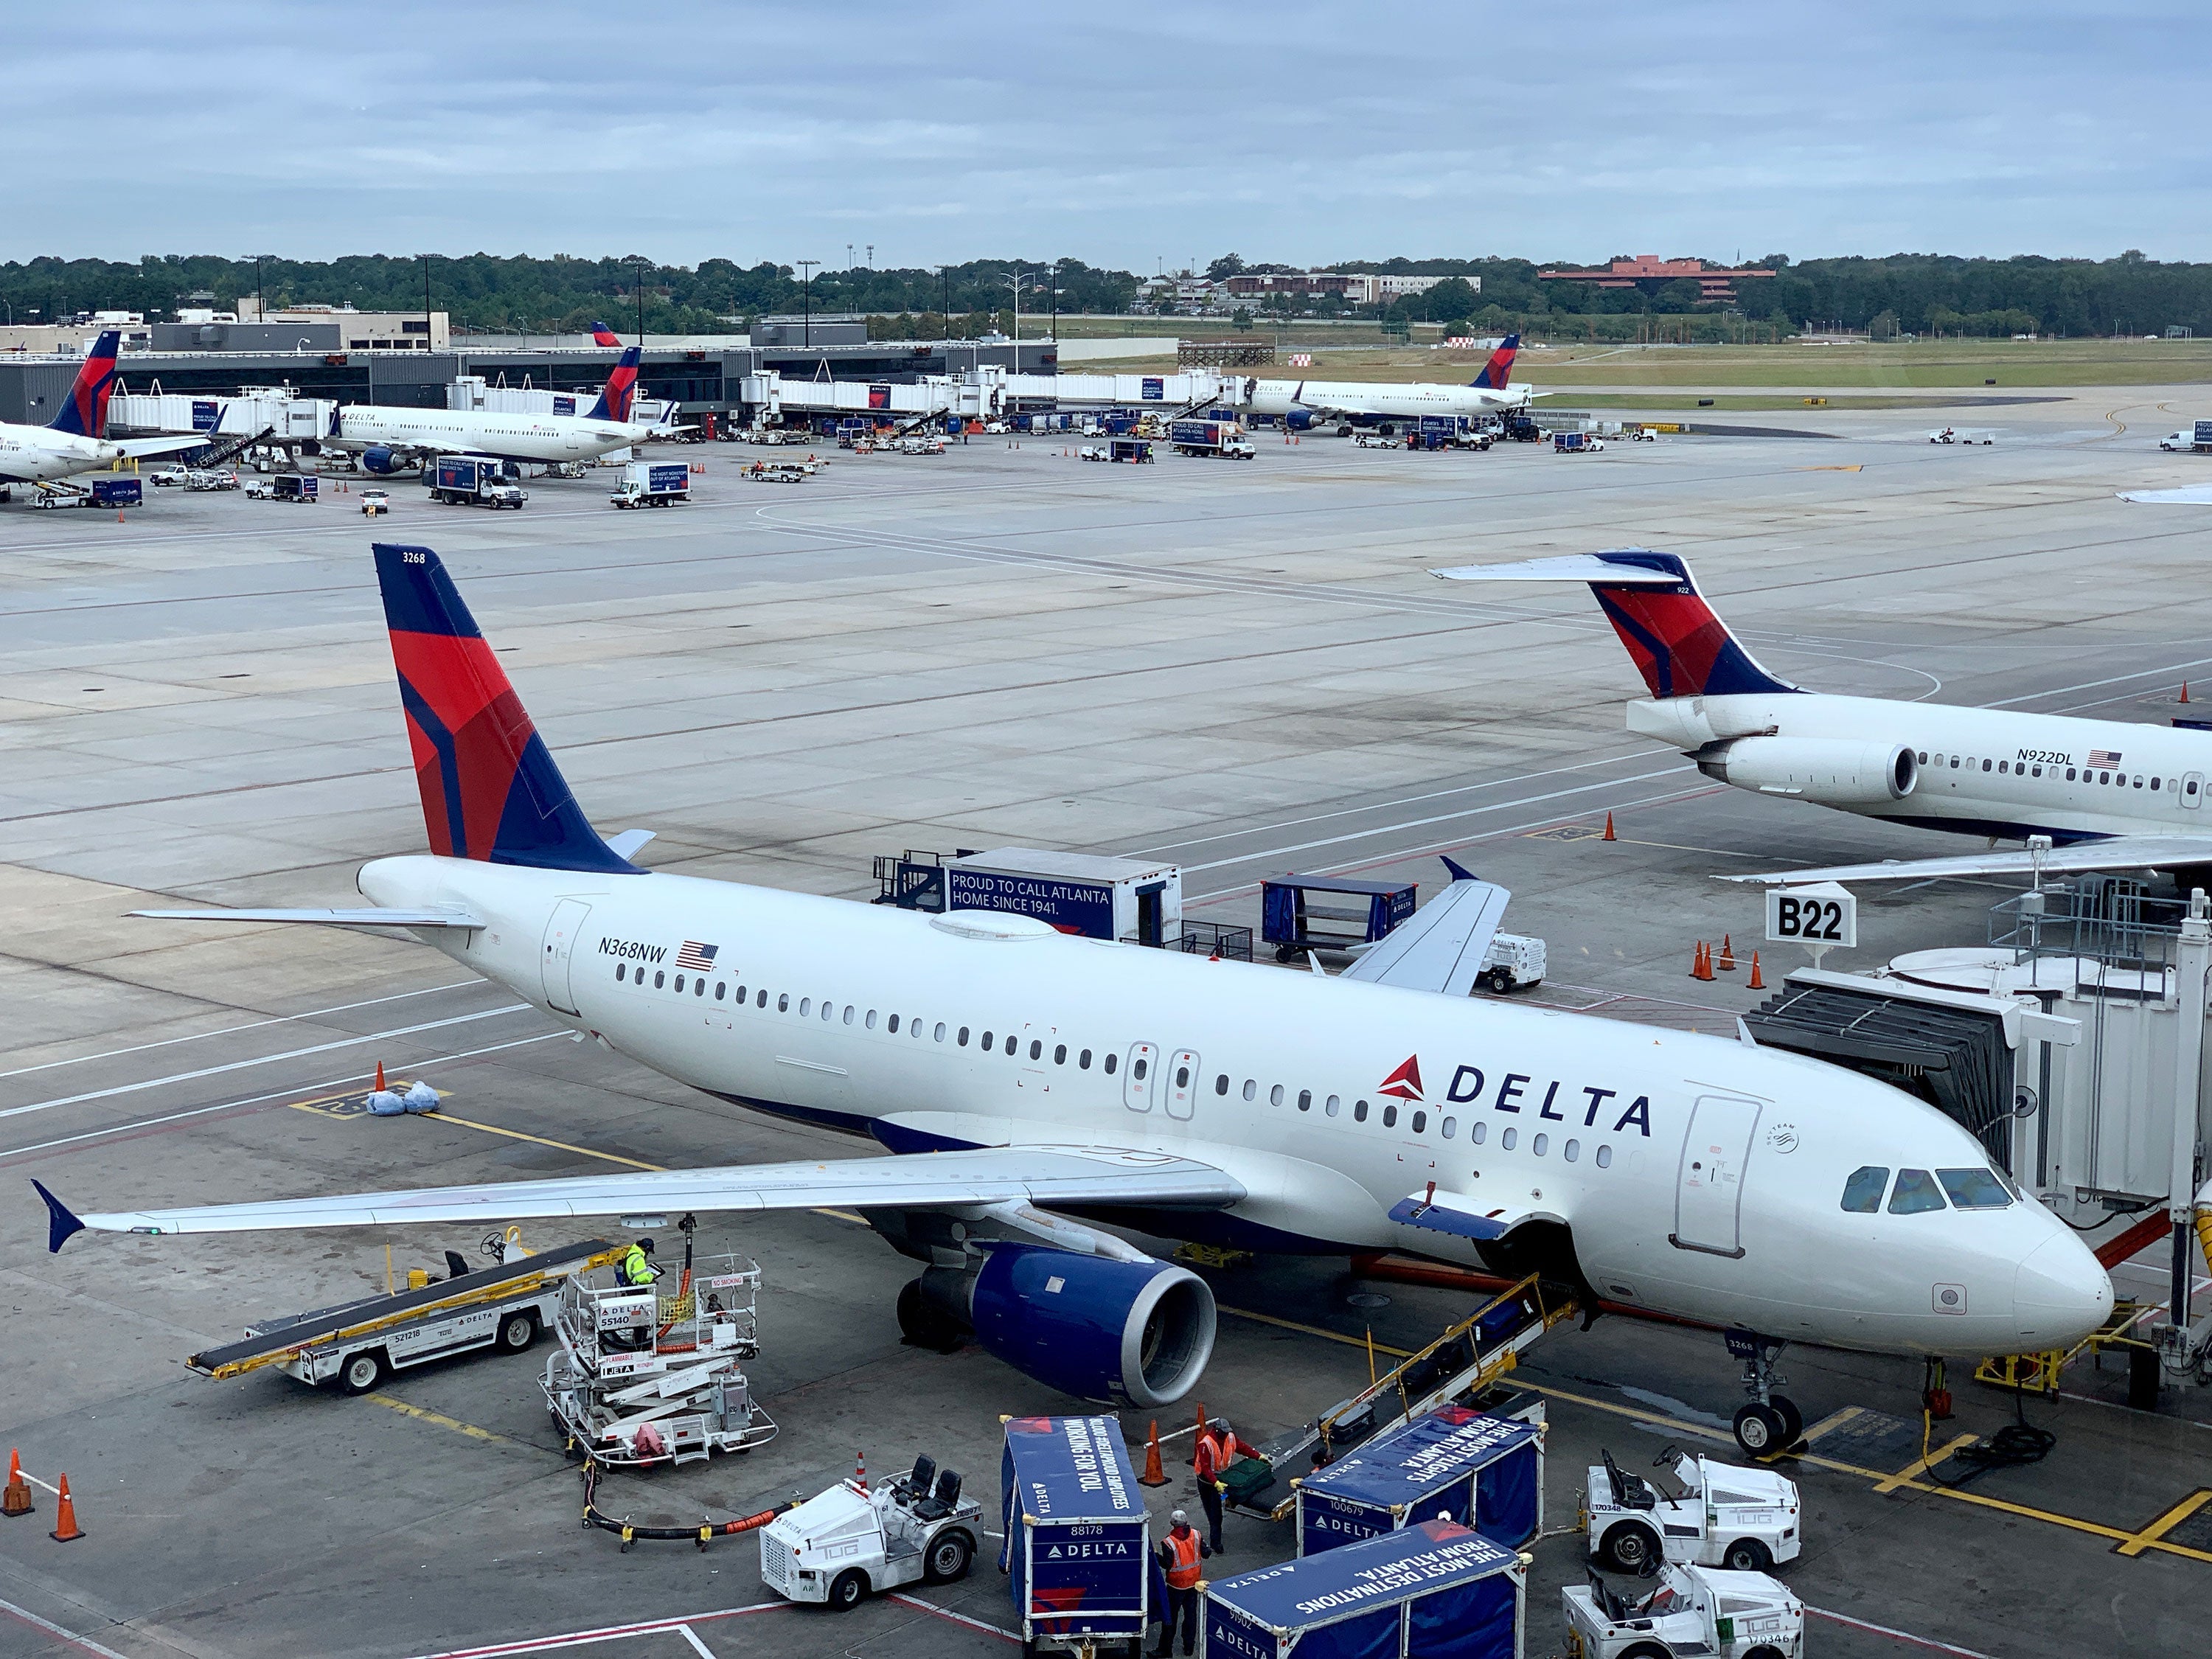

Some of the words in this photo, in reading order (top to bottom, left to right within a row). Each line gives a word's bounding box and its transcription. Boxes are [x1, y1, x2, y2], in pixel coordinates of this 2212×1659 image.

[403, 552, 425, 564] 3268
[1677, 586, 1689, 594] 922
[2017, 748, 2073, 766] N922DL
[953, 874, 994, 891] PROUD
[997, 880, 1014, 894] TO
[1018, 882, 1048, 897] CALL
[1051, 886, 1109, 905] ATLANTA
[953, 891, 990, 907] HOME
[992, 894, 1027, 912] SINCE
[1030, 900, 1059, 915] 1941.
[1397, 901, 1411, 911] DELTA
[1778, 897, 1842, 941] B22
[598, 937, 667, 964] N368NW
[1446, 1064, 1652, 1138] DELTA
[1766, 1123, 1795, 1146] SKYTEAM
[720, 1277, 742, 1285] SMOKING
[467, 1312, 493, 1324] DELTA
[612, 1304, 644, 1314] DELTA
[601, 1316, 629, 1326] 55140
[394, 1329, 420, 1343] 521218
[1729, 1339, 1753, 1351] 3268
[606, 1354, 633, 1363] FLAMMABLE
[608, 1366, 623, 1374] JET
[1062, 1419, 1093, 1454] WORKING
[1455, 1416, 1500, 1440] FROM
[1493, 1422, 1522, 1441] THE
[1399, 1436, 1459, 1467] ATLANTA.
[1461, 1434, 1499, 1459] MOST
[1073, 1455, 1097, 1471] FOR
[1406, 1455, 1464, 1484] FLIGHTS
[1078, 1472, 1103, 1492] YOU.
[1316, 1464, 1356, 1483] DELTA
[1034, 1489, 1051, 1514] DELTA
[1106, 1475, 1130, 1510] EMPLOYEES
[1329, 1500, 1363, 1517] 100679
[1595, 1504, 1621, 1512] 170348
[1729, 1508, 1775, 1525] TUG
[782, 1520, 802, 1534] DELTA
[1071, 1525, 1103, 1536] 88178
[1332, 1519, 1380, 1538] DELTA
[815, 1539, 859, 1560] TUG
[1068, 1543, 1127, 1557] DELTA
[1436, 1540, 1492, 1557] FROM
[1473, 1548, 1509, 1565] THE
[1354, 1550, 1441, 1580] ATLANTA.
[1425, 1555, 1475, 1579] MOST
[1225, 1570, 1281, 1588] DELTA
[1295, 1571, 1425, 1614] DESTINATIONS
[1229, 1609, 1252, 1630] 91902
[1738, 1613, 1781, 1634] TUG
[1228, 1631, 1267, 1659] DELTA
[1748, 1634, 1790, 1644] 170346
